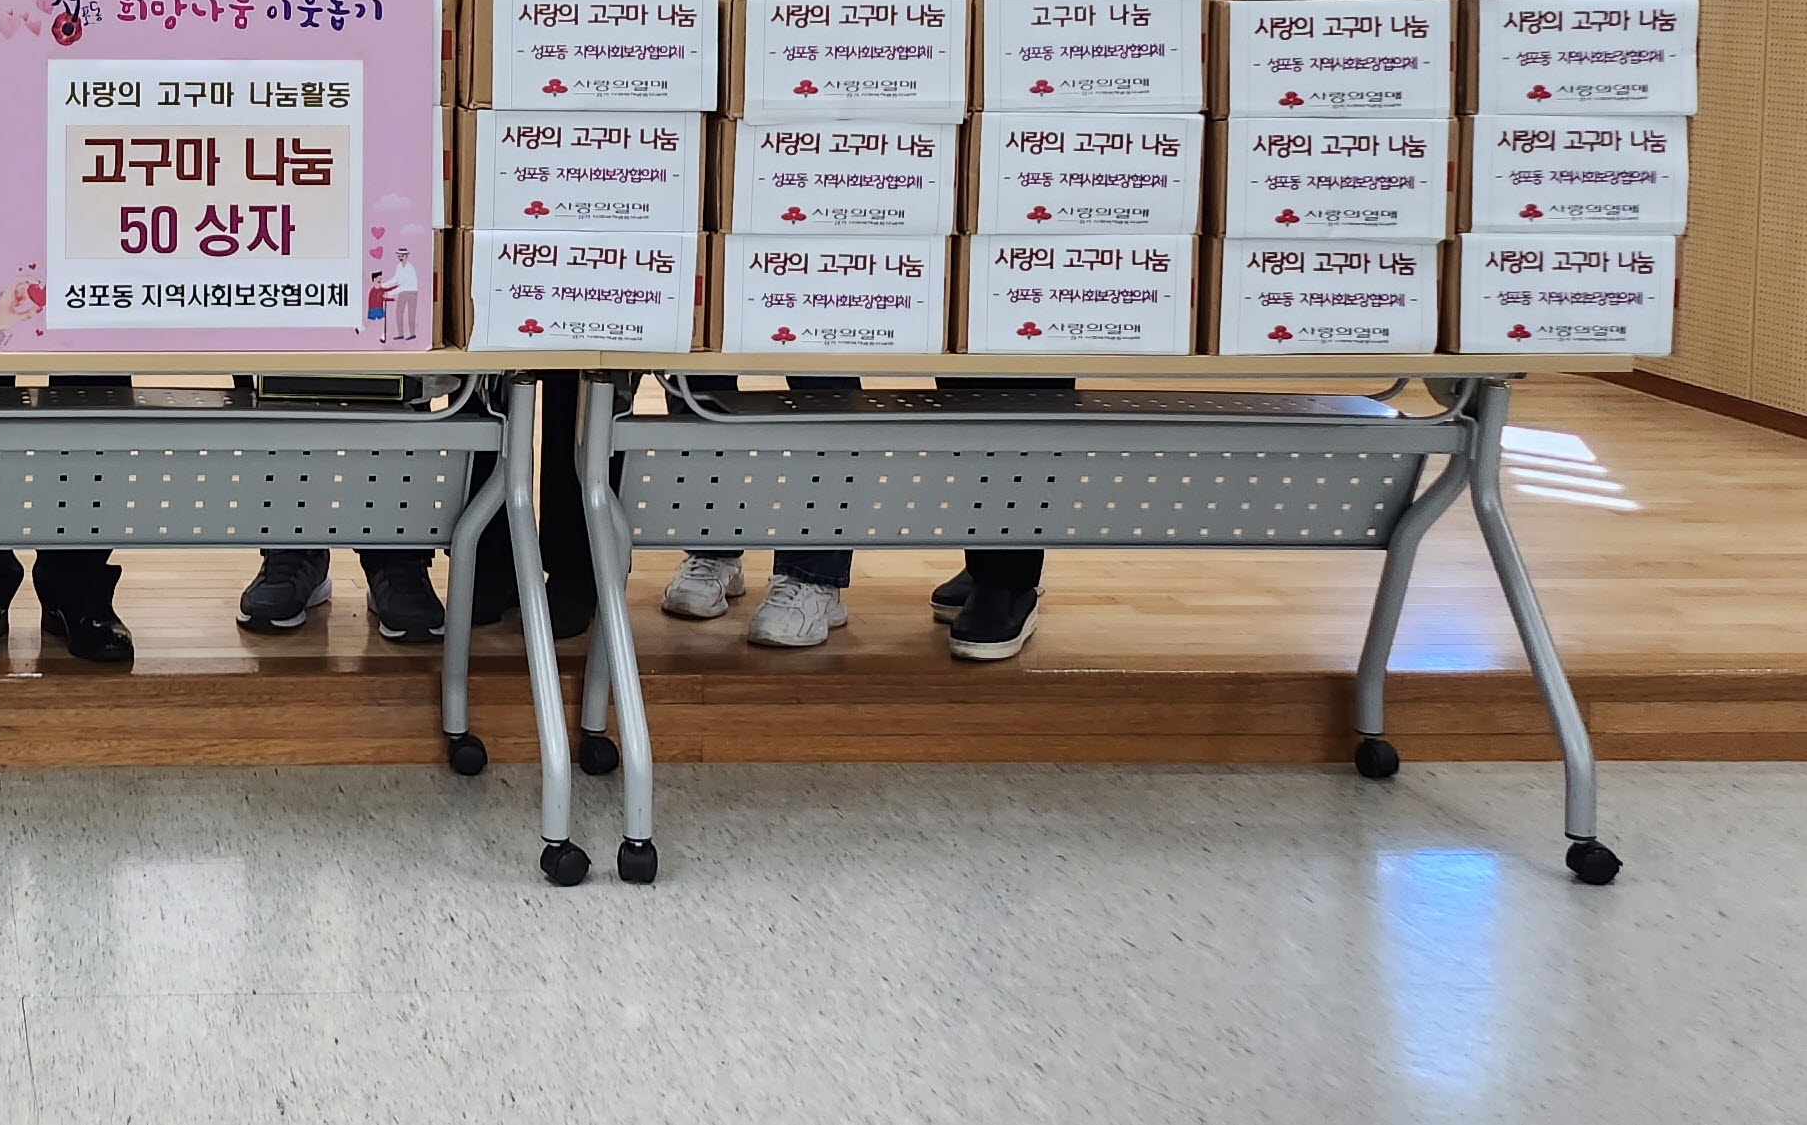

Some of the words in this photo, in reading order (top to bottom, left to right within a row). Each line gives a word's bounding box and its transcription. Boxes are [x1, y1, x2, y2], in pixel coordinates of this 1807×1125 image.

[517, 3, 579, 28] 사랑의
[587, 3, 650, 27] 고구마
[657, 3, 698, 28] 나눔
[770, 4, 830, 29] 사랑의
[838, 4, 899, 28] 고구마
[906, 3, 946, 28] 나눔
[1030, 4, 1097, 28] 고구마
[1109, 3, 1152, 27] 나눔
[1253, 16, 1315, 41] 사랑의
[1322, 15, 1383, 39] 고구마
[1390, 14, 1430, 39] 나눔
[1502, 10, 1564, 35] 사랑의
[1570, 9, 1632, 33] 고구마
[1638, 8, 1678, 33] 나눔
[530, 44, 569, 61] 성포동
[573, 44, 685, 61] 지역사회보장협의체
[64, 80, 142, 109] 사랑의
[157, 82, 235, 108] 고구마
[248, 81, 352, 109] 나눔활동
[573, 80, 667, 91] 사랑의열매
[501, 125, 562, 150] 사랑의
[570, 126, 632, 150] 고구마
[639, 127, 680, 152] 나눔
[760, 131, 821, 156] 사랑의
[828, 133, 889, 157] 고구마
[896, 133, 936, 158] 나눔
[1004, 130, 1065, 156] 사랑의
[1072, 132, 1134, 156] 고구마
[1141, 133, 1182, 158] 나눔
[1252, 134, 1312, 159] 사랑의
[1320, 134, 1381, 158] 고구마
[1388, 134, 1428, 159] 나눔
[1496, 129, 1556, 154] 사랑의
[1562, 129, 1623, 153] 고구마
[1630, 129, 1668, 154] 나눔
[81, 137, 221, 187] 고구마
[245, 137, 333, 187] 나눔
[119, 206, 179, 256] 50
[193, 203, 296, 257] 상자
[497, 242, 558, 268] 사랑의
[566, 246, 628, 271] 고구마
[635, 249, 676, 274] 나눔
[748, 251, 809, 277] 사랑의
[816, 253, 878, 277] 고구마
[885, 254, 925, 278] 나눔
[994, 247, 1055, 272] 사랑의
[1062, 248, 1124, 272] 고구마
[1131, 248, 1172, 273] 나눔
[1246, 250, 1305, 276] 사랑의
[1312, 252, 1372, 275] 고구마
[1378, 252, 1418, 277] 나눔
[1484, 250, 1544, 275] 사랑의
[1551, 250, 1611, 274] 고구마
[1617, 250, 1656, 275] 나눔
[64, 283, 134, 310] 성포동
[141, 283, 350, 309] 지역사회보장협의체
[760, 292, 798, 309] 성포동
[802, 293, 912, 310] 지역사회보장협의체
[1496, 290, 1534, 306] 성포동
[1537, 291, 1644, 307] 지역사회보장협의체
[802, 329, 894, 340] 사랑의열매
